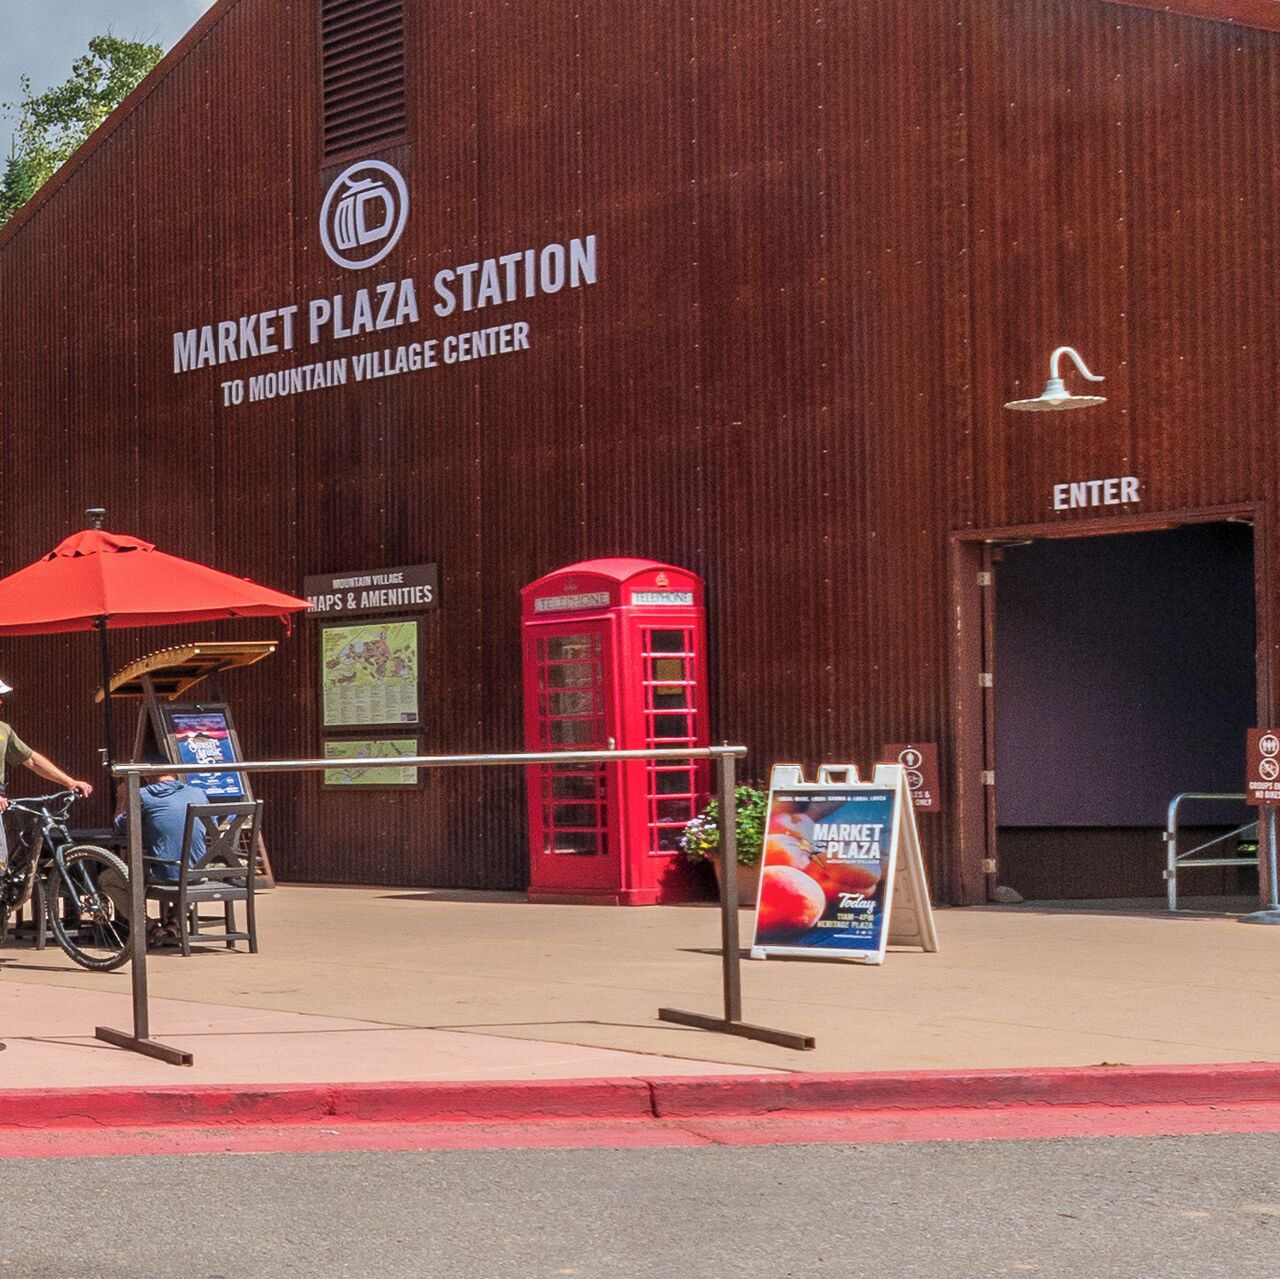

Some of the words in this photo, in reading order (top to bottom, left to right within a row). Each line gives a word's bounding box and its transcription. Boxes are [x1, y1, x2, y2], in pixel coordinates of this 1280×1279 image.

[173, 305, 298, 374] MARKET
[309, 277, 419, 344] PLAZA
[433, 234, 598, 318] STATION
[220, 379, 244, 408] TO
[249, 357, 347, 403] MOUNTAIN
[352, 339, 439, 383] VILLAGE
[442, 321, 531, 365] CENTER
[1053, 476, 1141, 511] ENTER
[332, 575, 372, 589] MOUNTAIN
[372, 572, 404, 585] VILLAGE
[306, 594, 343, 613] MAPS
[346, 592, 357, 609] &
[360, 584, 433, 608] AMENITIES
[635, 592, 690, 604] TELEPHONE
[813, 823, 884, 841] MARKET
[826, 841, 881, 859] PLAZA
[838, 892, 877, 914] Today
[850, 921, 874, 929] PLAZA
